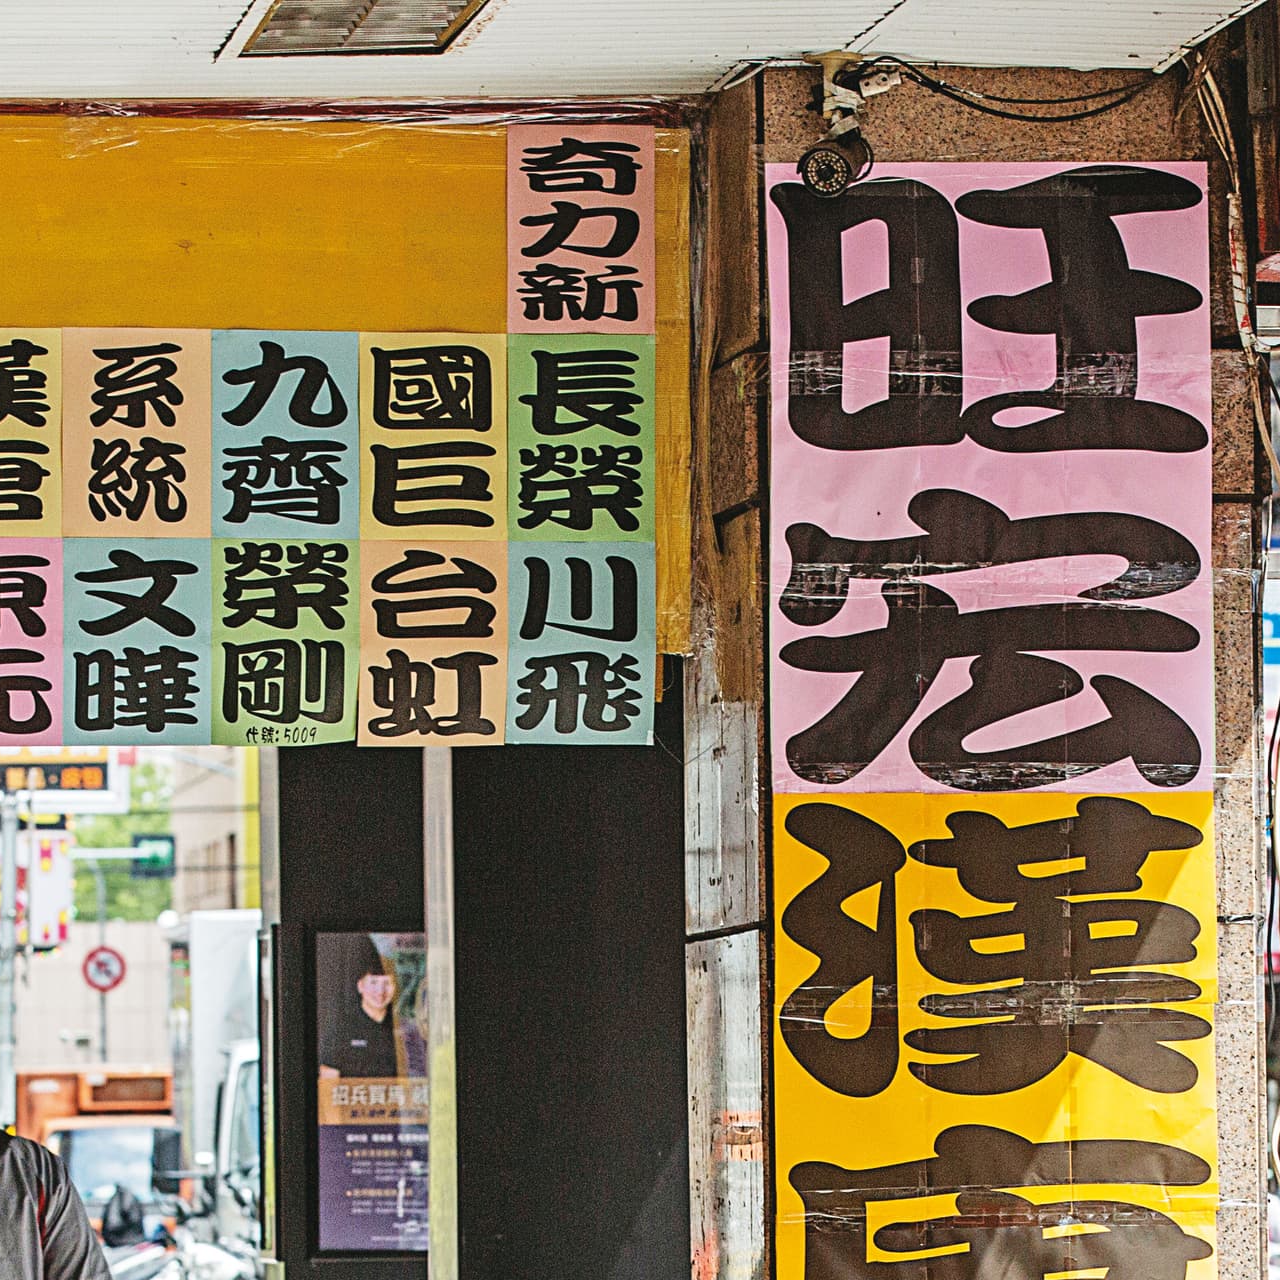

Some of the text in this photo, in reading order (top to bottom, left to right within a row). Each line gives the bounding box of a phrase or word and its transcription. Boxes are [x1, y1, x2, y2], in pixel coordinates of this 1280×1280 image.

[516, 137, 644, 322] 奇力新
[88, 342, 188, 523] 系統
[221, 340, 349, 525] 九齊
[369, 345, 497, 528] 國巨
[517, 349, 645, 532] 長榮
[770, 164, 1210, 792] 旺宏
[72, 549, 201, 733] 文曄
[221, 540, 350, 725] 榮剛
[367, 549, 499, 738] 台虹
[515, 555, 643, 734] 川飛
